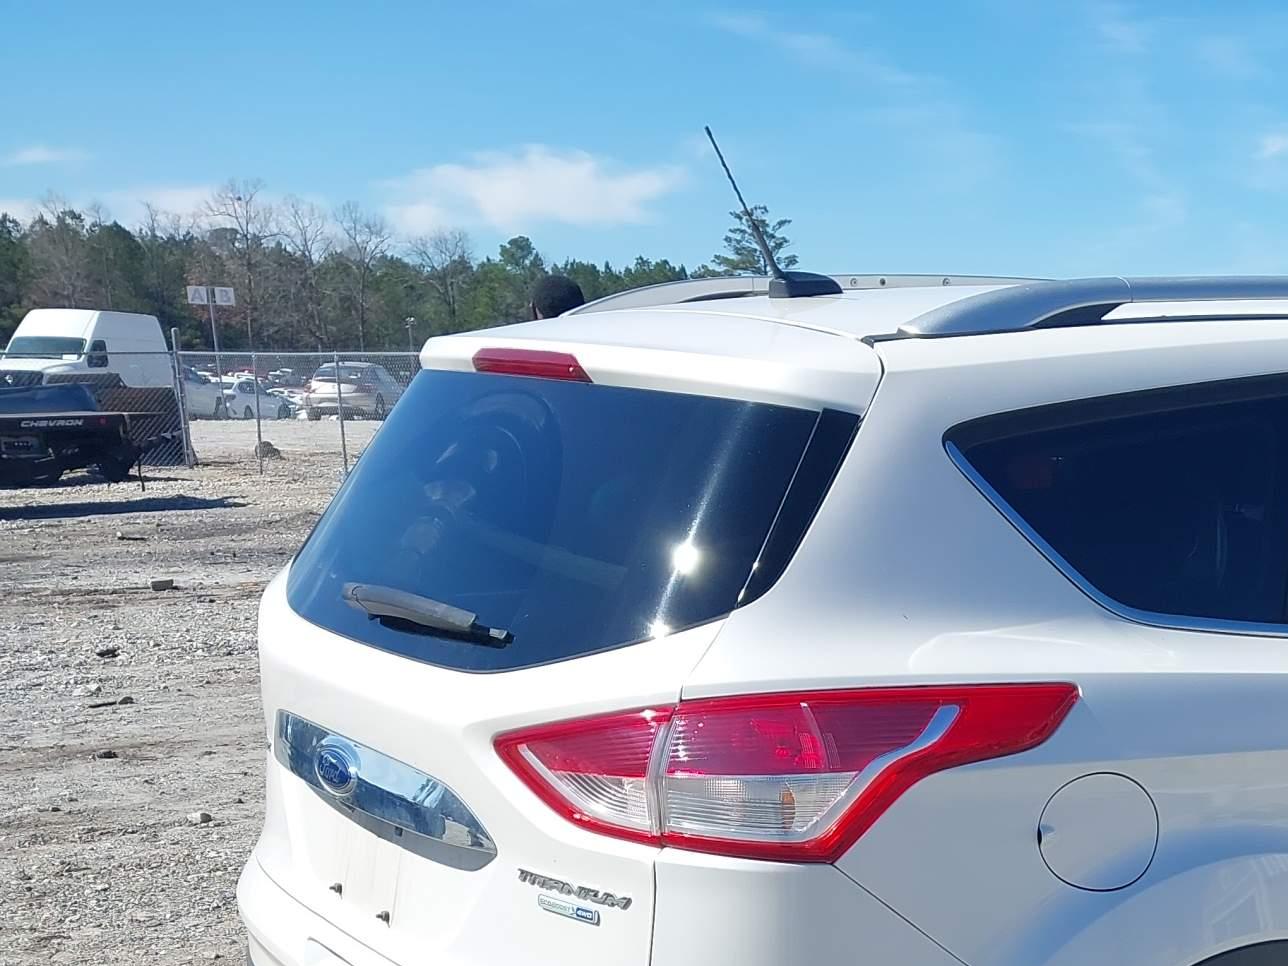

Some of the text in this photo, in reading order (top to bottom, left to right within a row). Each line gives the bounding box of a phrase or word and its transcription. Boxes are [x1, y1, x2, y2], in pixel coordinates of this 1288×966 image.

[191, 288, 205, 302] A
[219, 289, 232, 303] B
[20, 418, 85, 428] CHEVRON
[517, 867, 633, 911] TITANIUM
